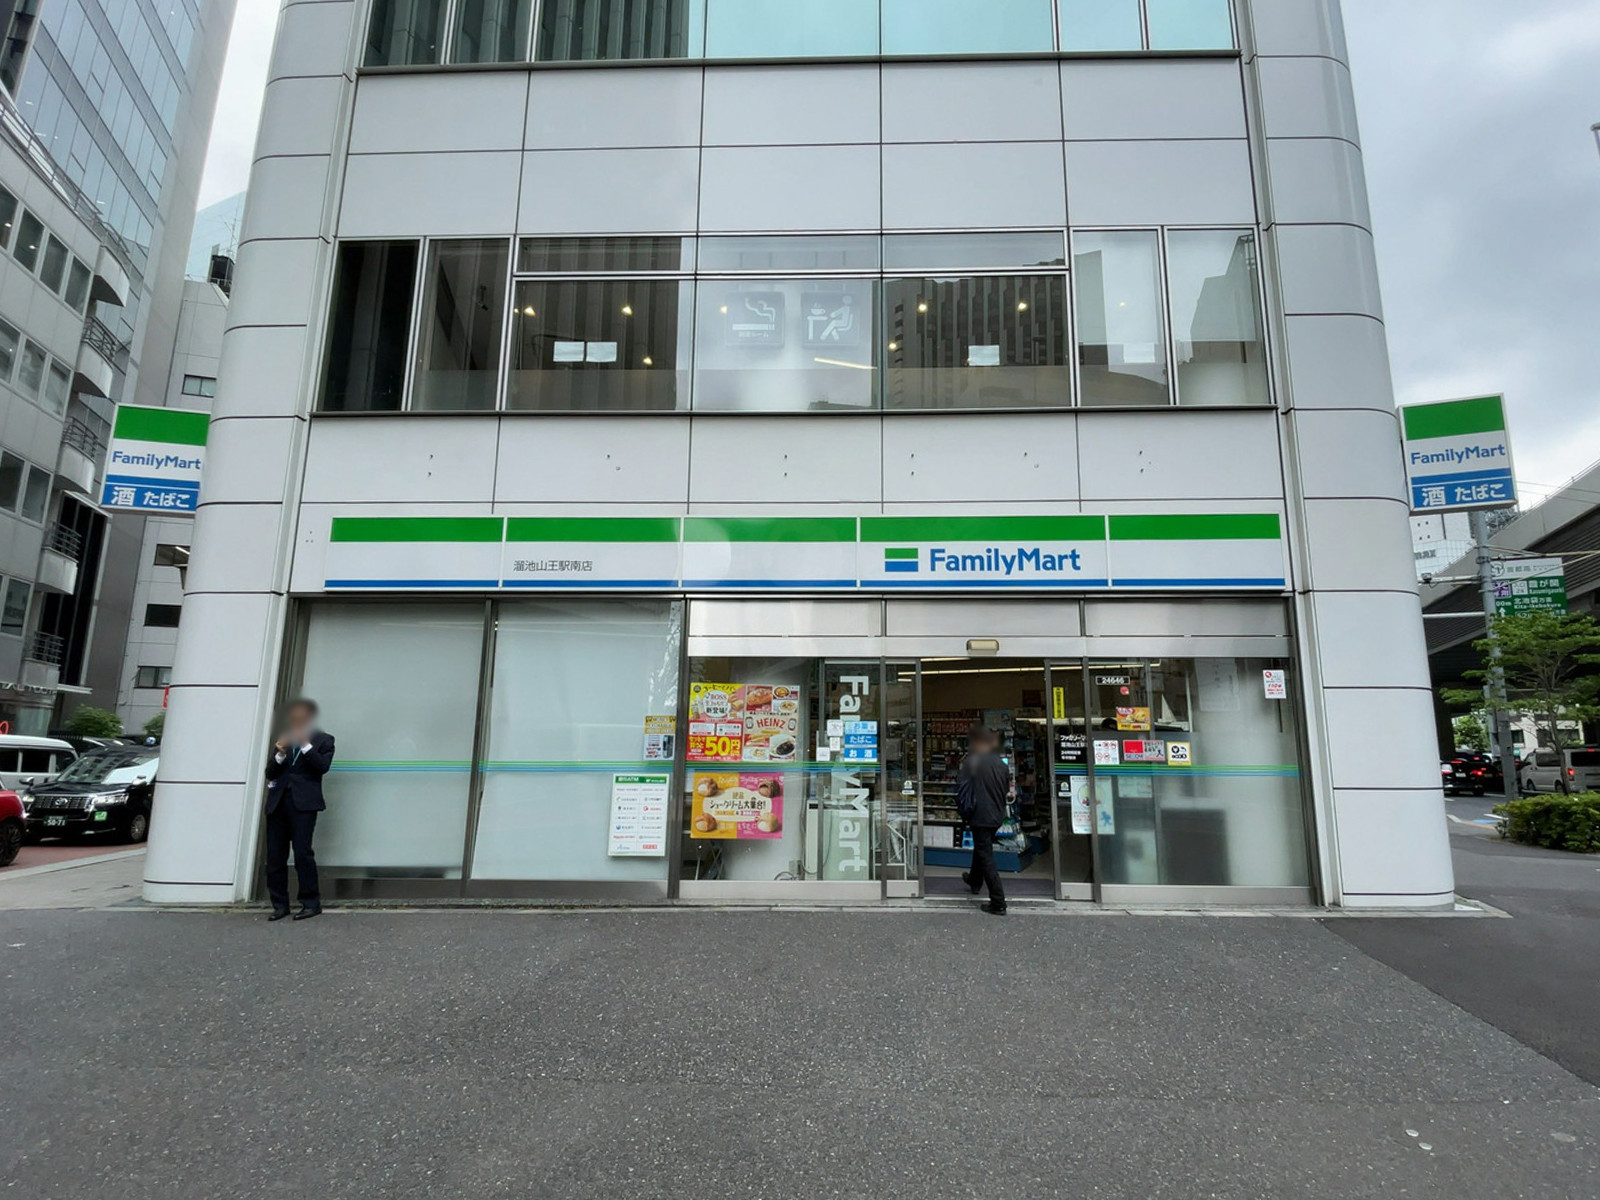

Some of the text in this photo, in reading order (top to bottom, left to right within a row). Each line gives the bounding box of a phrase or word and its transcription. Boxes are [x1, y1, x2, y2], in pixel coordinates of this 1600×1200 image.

[112, 450, 201, 470] FamilyMart
[1411, 444, 1506, 465] FamilyMart
[111, 486, 191, 508] 酒 たばこ
[1421, 483, 1506, 506] 酒 たばこ
[513, 560, 593, 572] 溜池山王駅南店
[929, 548, 1081, 575] FamilyMart
[756, 717, 786, 729] HEINZ
[850, 735, 873, 744] たばこ
